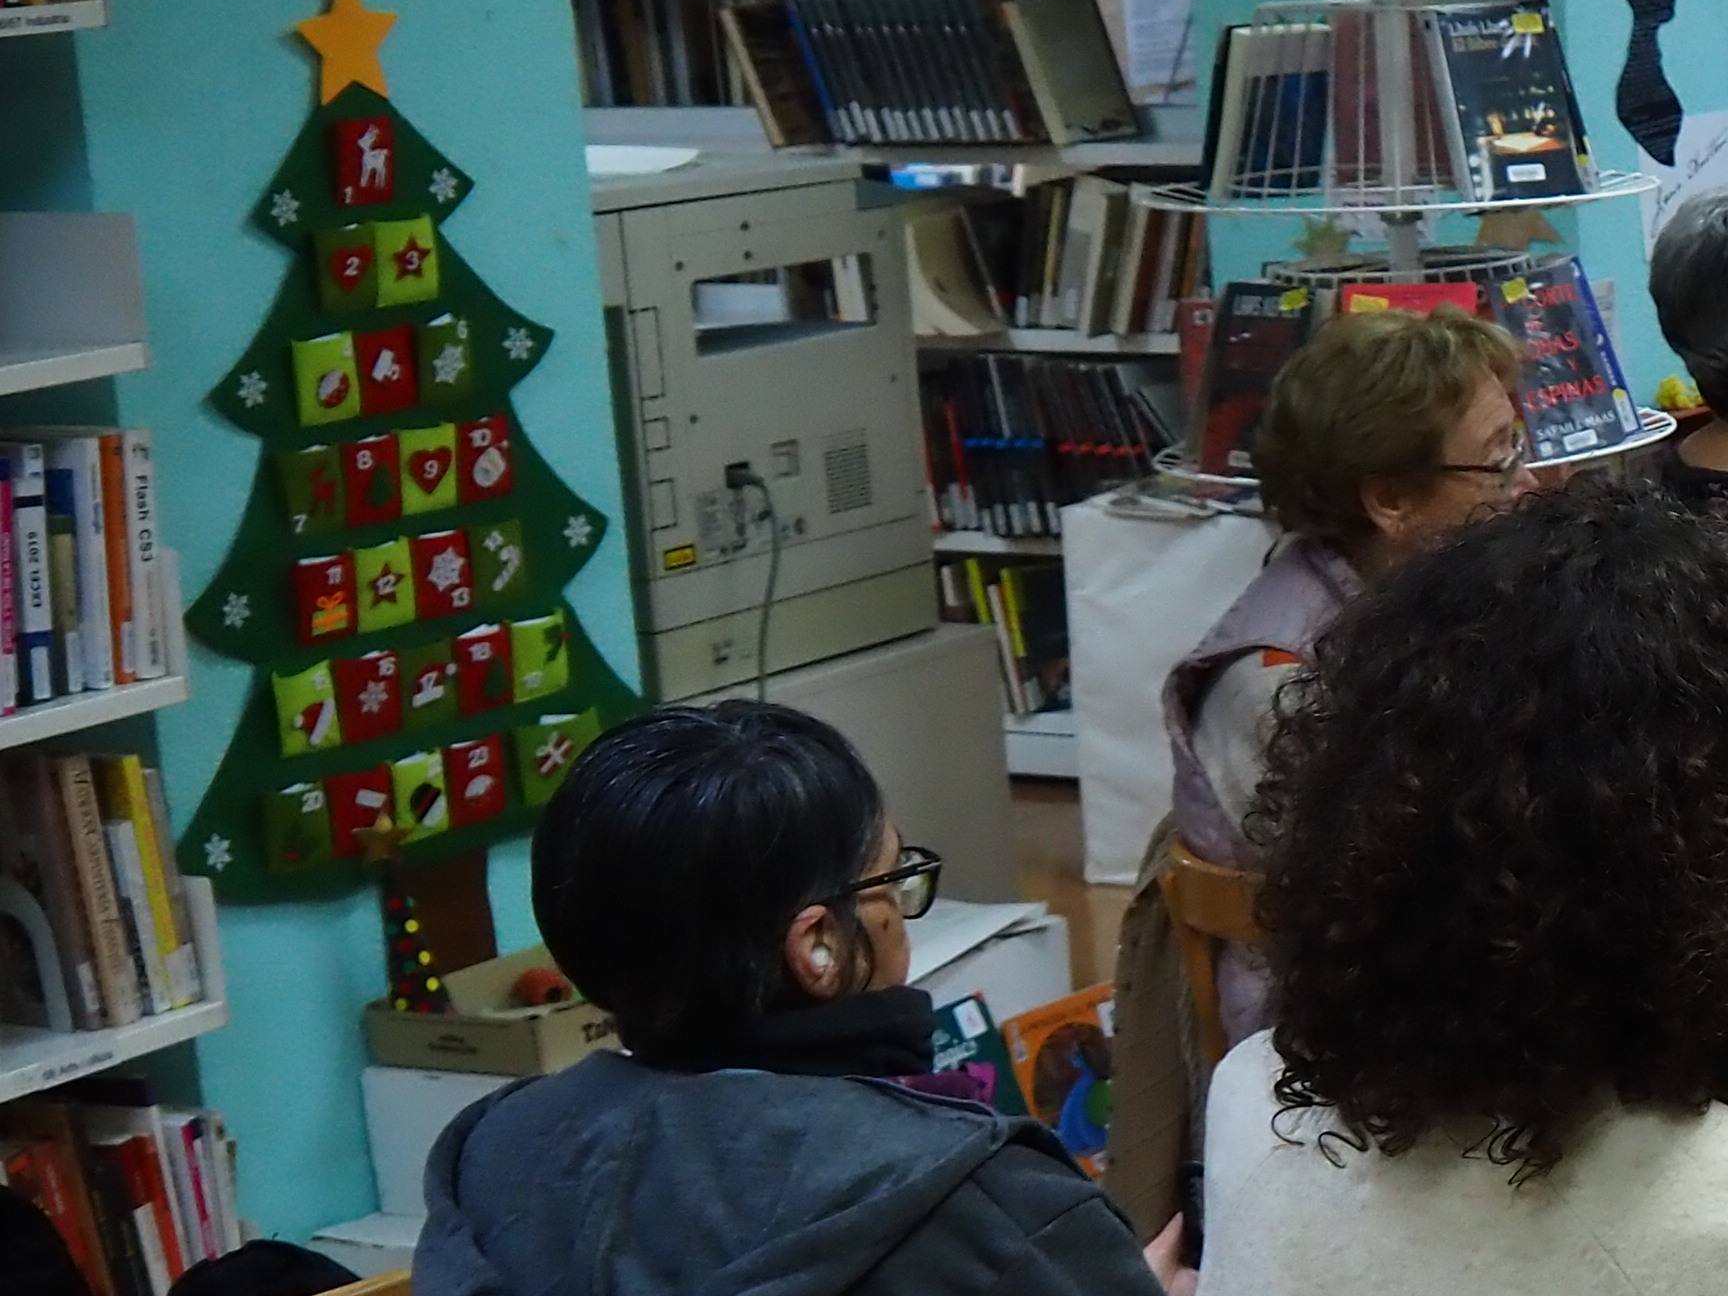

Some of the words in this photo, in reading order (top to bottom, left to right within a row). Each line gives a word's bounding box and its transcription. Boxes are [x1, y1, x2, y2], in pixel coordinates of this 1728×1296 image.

[342, 187, 353, 204] 1
[345, 255, 361, 277] 2
[405, 250, 421, 271] 3
[355, 450, 374, 470] 8
[423, 459, 439, 481] 9
[134, 475, 151, 521] Flash
[293, 514, 308, 533] 7
[27, 531, 40, 564] 2019
[138, 529, 154, 563] CS3
[28, 571, 43, 609] EXCEL
